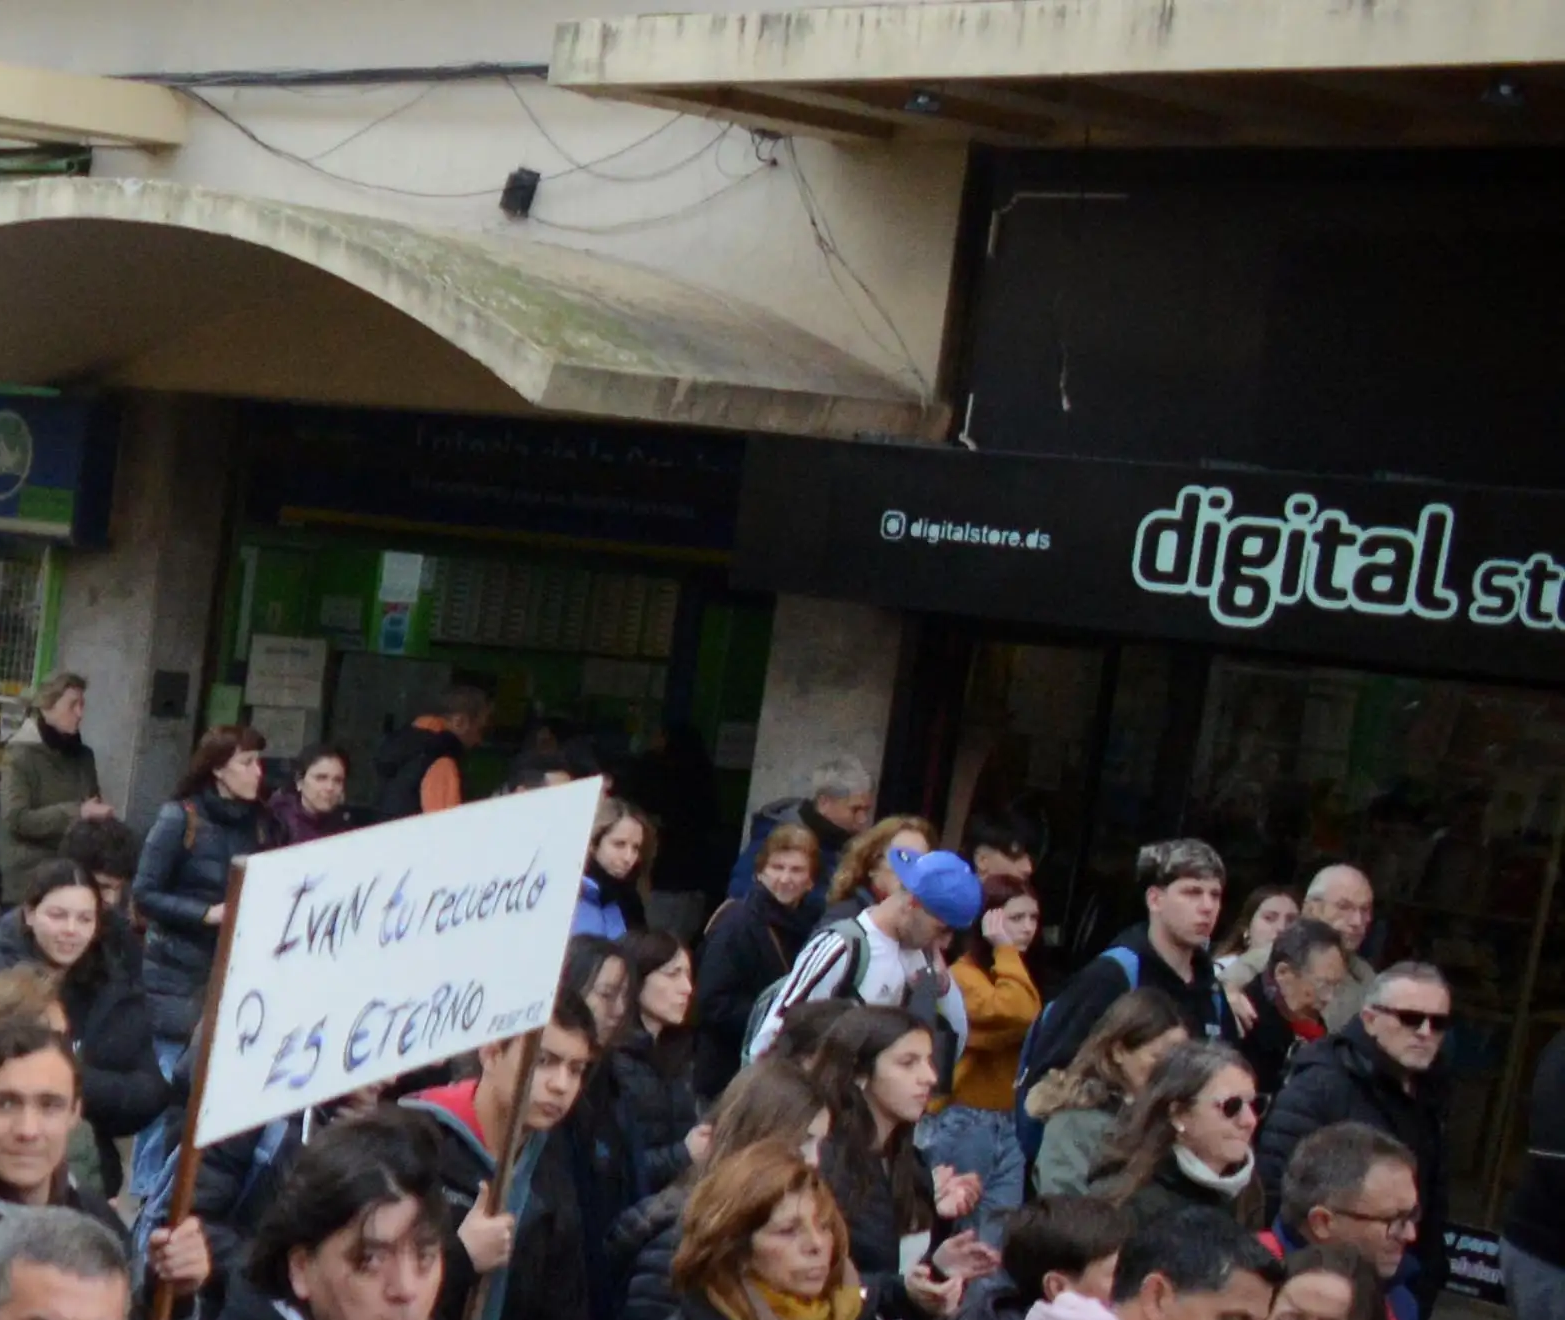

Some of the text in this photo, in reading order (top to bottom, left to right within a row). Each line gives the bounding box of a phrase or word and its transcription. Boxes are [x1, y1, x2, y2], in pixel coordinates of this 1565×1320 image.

[910, 517, 1051, 550] digitalstore.ds
[1132, 484, 1565, 631] digital st
[378, 866, 416, 949] tu
[418, 846, 549, 937] recuerdo
[262, 980, 485, 1092] ES ETERNO
